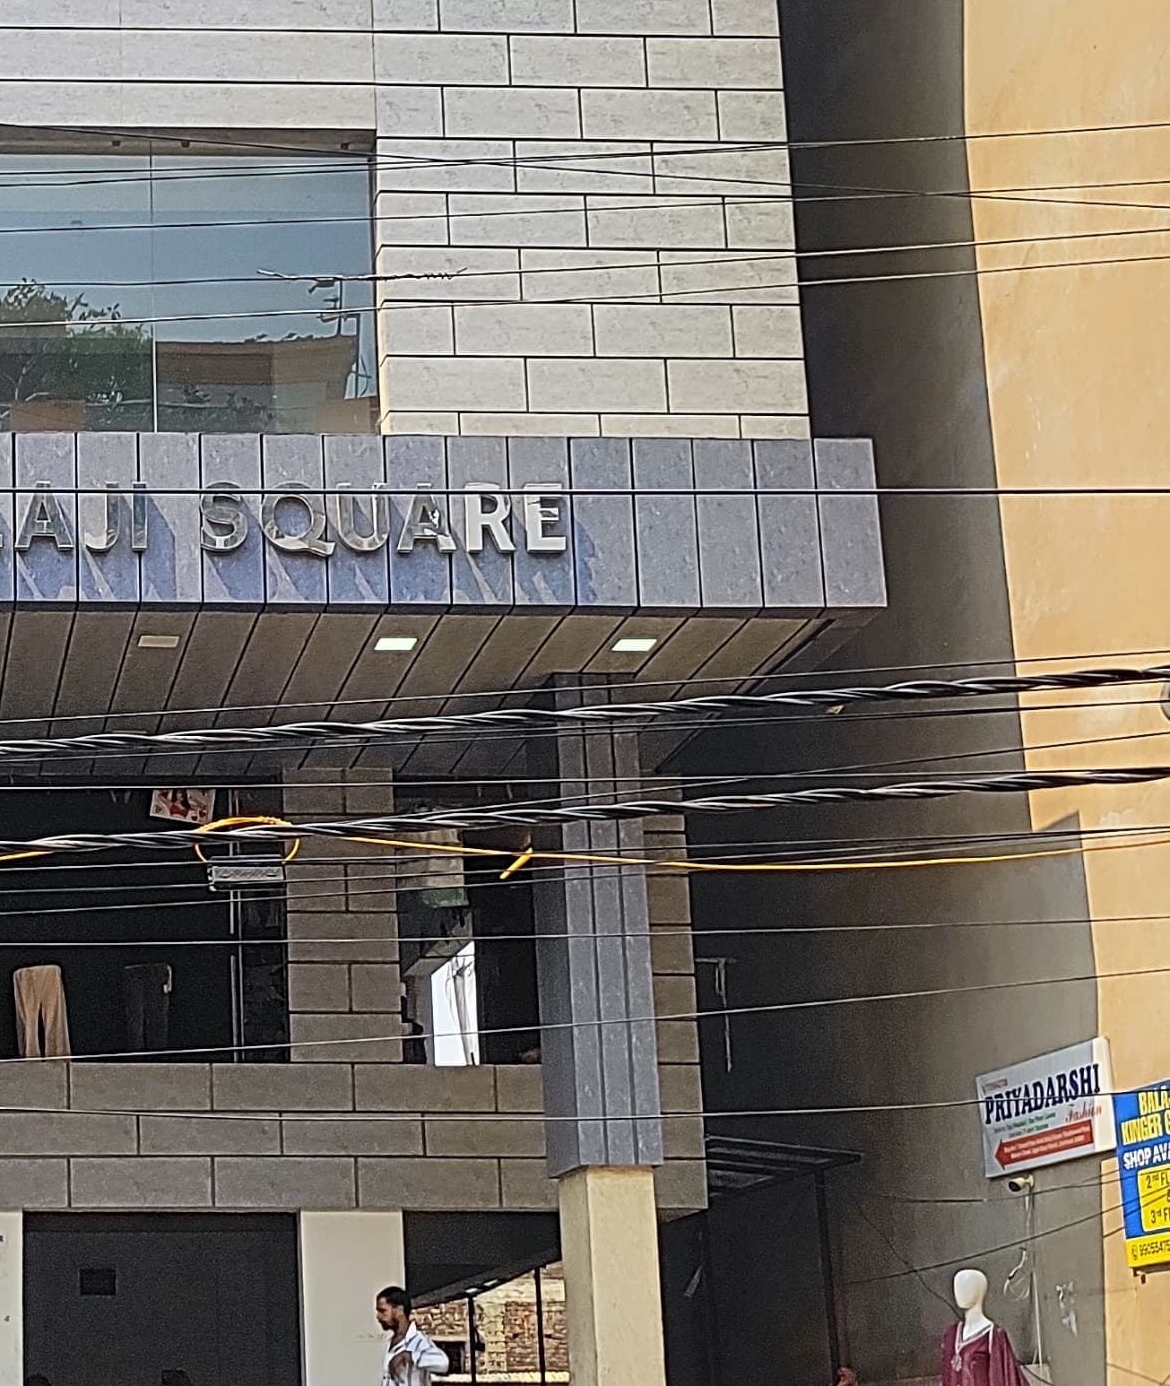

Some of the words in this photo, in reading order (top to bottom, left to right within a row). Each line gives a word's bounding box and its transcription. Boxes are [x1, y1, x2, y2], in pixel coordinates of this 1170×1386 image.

[200, 480, 567, 556] SQUARE
[984, 1063, 1101, 1125] PRIYADARSHI
[1138, 1085, 1170, 1115] BALA
[1123, 1147, 1152, 1169] SHOP
[1152, 1142, 1170, 1164] AV
